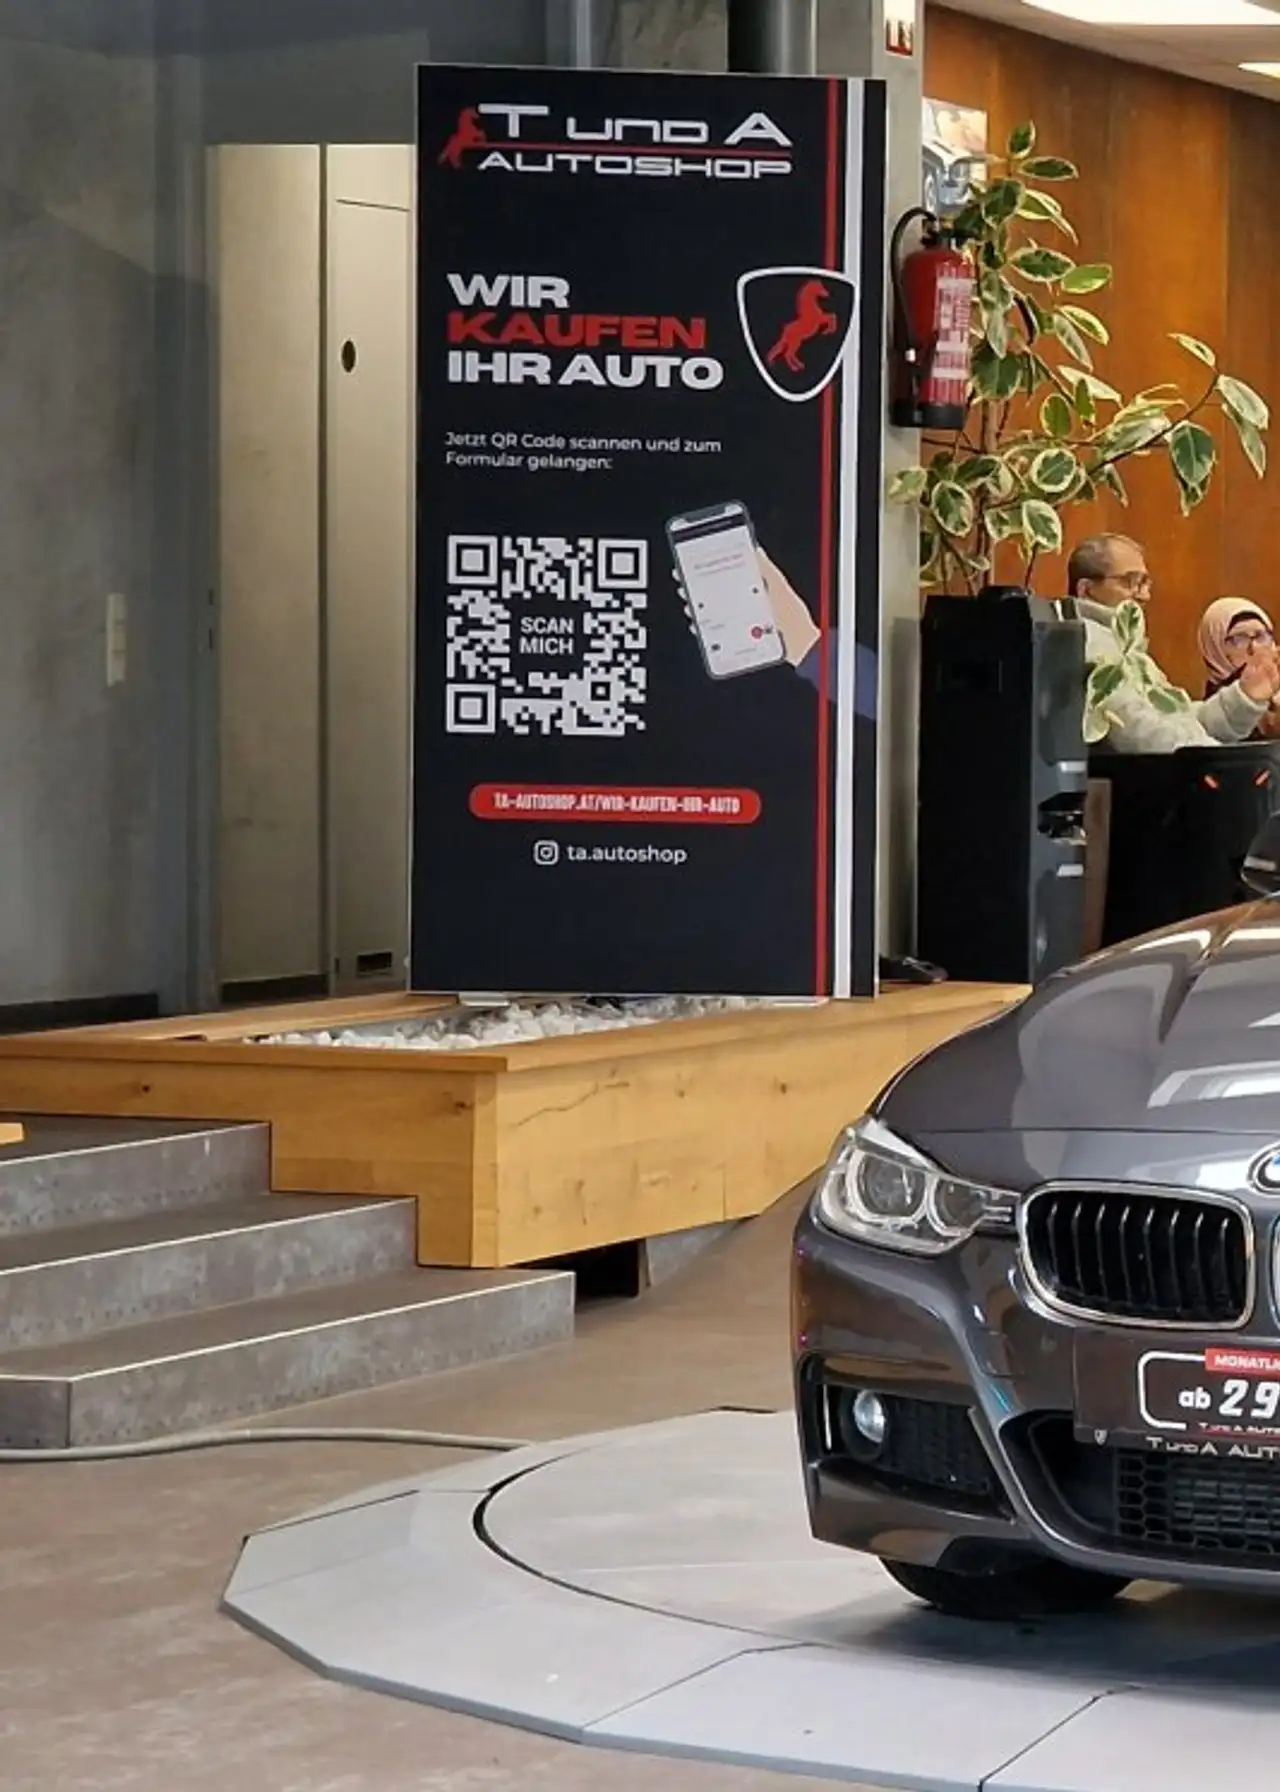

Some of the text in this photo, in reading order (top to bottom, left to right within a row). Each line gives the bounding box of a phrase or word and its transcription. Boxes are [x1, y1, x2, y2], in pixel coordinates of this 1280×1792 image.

[480, 104, 549, 137] T
[724, 112, 792, 146] A
[478, 151, 792, 179] AUTOSHOP
[447, 274, 570, 309] WIR
[447, 312, 706, 349] KAUFEN
[448, 352, 723, 389] IHR AUTO
[445, 432, 722, 453] Jetzt QR Code scannen und zum
[446, 451, 613, 472] Formular gelangen:
[520, 616, 574, 635] SCAN
[519, 636, 574, 656] MICH
[567, 845, 688, 865] ta.autoshop
[1178, 1387, 1212, 1410] ab
[1146, 1437, 1163, 1450] T
[1199, 1441, 1218, 1456] A
